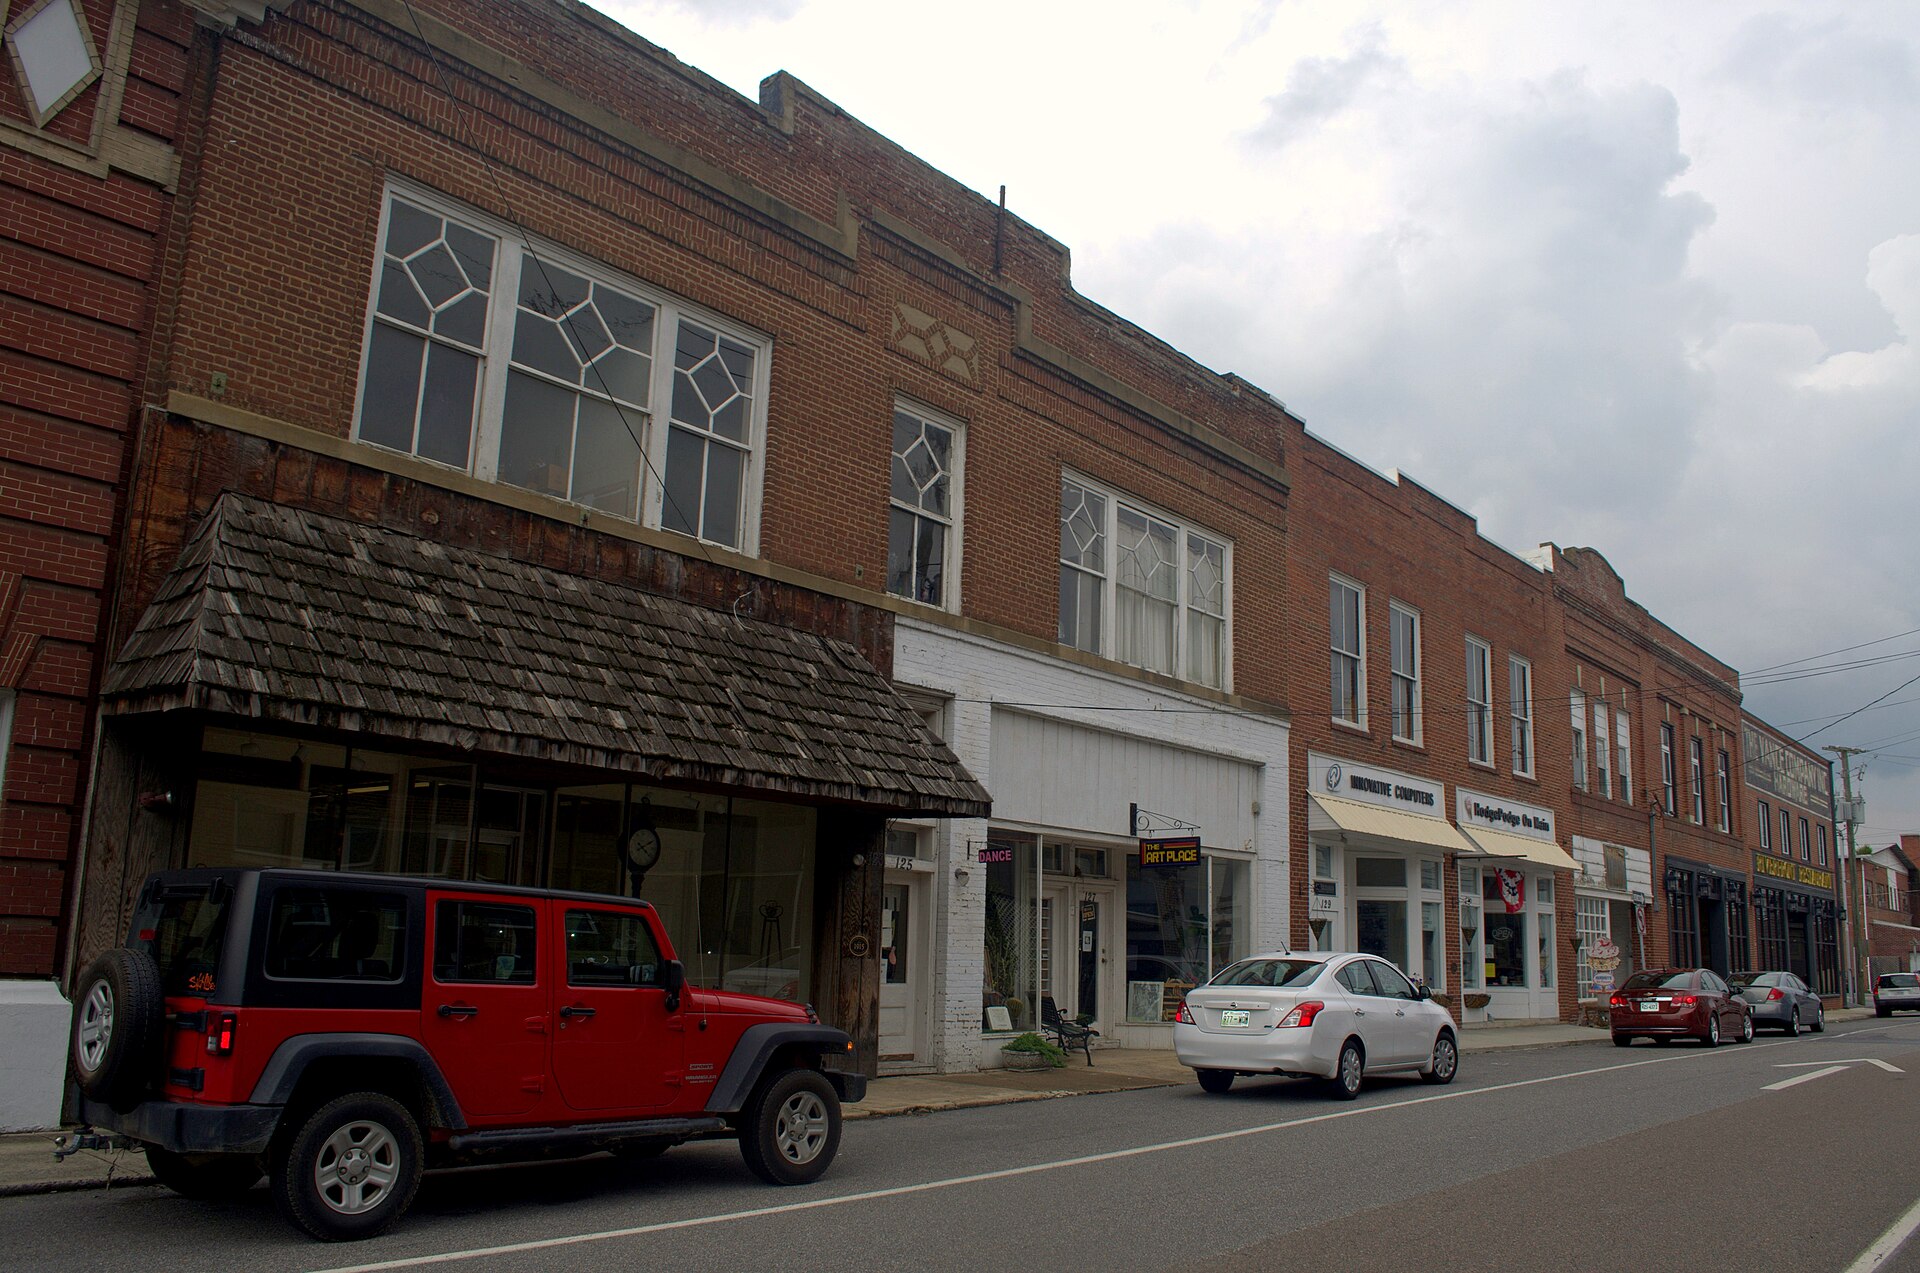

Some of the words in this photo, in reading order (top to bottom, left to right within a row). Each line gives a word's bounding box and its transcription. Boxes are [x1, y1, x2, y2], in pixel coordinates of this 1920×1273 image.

[1350, 775, 1392, 797] INNOVATIVE
[1395, 785, 1434, 806] COMPUTERS
[1474, 802, 1520, 827] HodgePodge
[1522, 814, 1532, 828] On
[1533, 816, 1550, 832] Main
[1146, 843, 1160, 851] THE
[979, 850, 1012, 862] DANCE
[1146, 851, 1165, 863] ART
[1166, 849, 1197, 862] PLACE
[896, 856, 913, 870] 125
[1085, 891, 1096, 902] 127
[1320, 899, 1331, 909] 129
[1492, 929, 1513, 939] OPEN
